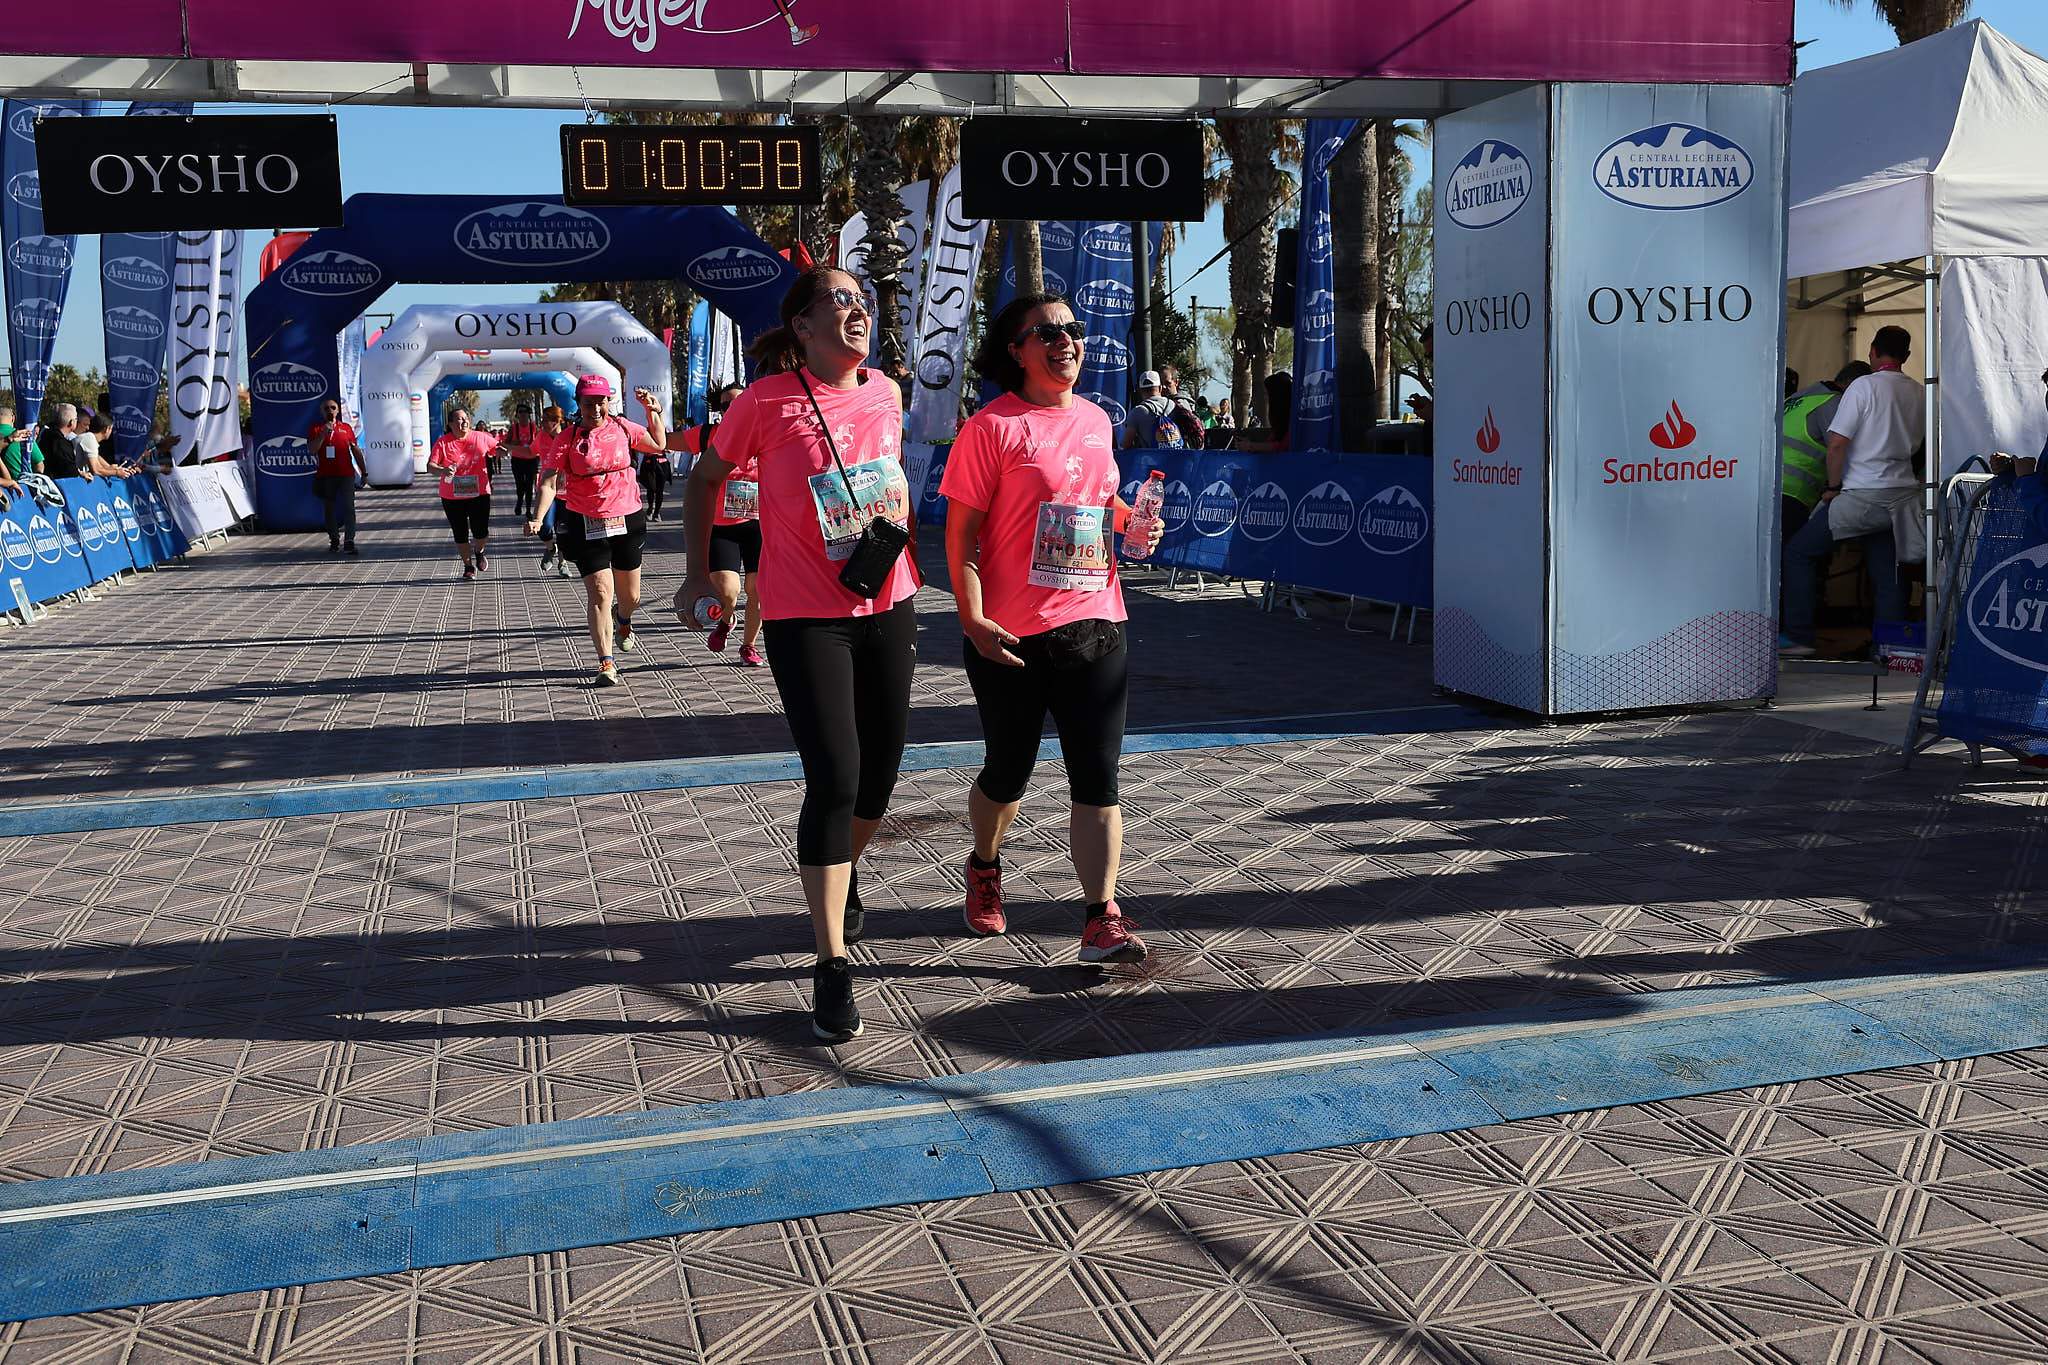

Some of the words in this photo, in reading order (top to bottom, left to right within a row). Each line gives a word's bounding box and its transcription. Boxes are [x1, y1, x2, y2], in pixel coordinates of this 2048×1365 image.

[1630, 153, 1680, 162] CENTRAL
[1685, 153, 1737, 162] LECHERA
[89, 154, 299, 194] OYSHO
[1001, 150, 1170, 188] OYSHO
[1462, 170, 1489, 184] CENTRAL
[1491, 163, 1522, 177] LECHERA
[1604, 155, 1742, 188] ASTURIANA
[1450, 175, 1526, 213] ASTURIANA
[466, 221, 600, 250] ASTURIANA
[1085, 233, 1133, 253] ASTURIA
[107, 264, 165, 286] ASTURIANA
[287, 268, 374, 284] ASTURIANA
[695, 264, 775, 281] ASTURIANA
[1445, 291, 1531, 336] OYSHO
[1587, 284, 1753, 325] OYSHO
[455, 311, 577, 338] OYSHO
[381, 343, 420, 351] OYSHO
[611, 336, 648, 344] OYSHO
[255, 376, 323, 393] ASTURIANA
[367, 391, 403, 400] OYSHO
[370, 440, 405, 449] OYSHO
[259, 450, 318, 466] ASTURIAN
[1453, 458, 1522, 485] Santander
[1602, 454, 1738, 485] Santander
[1194, 501, 1233, 523] ASTURIANA
[1242, 503, 1285, 526] ASTURIANA
[1296, 503, 1348, 531] ASTURIANA
[1361, 508, 1419, 539] ASTURIANA
[1036, 564, 1059, 573] CARRERA
[1040, 574, 1069, 585] OYSHO
